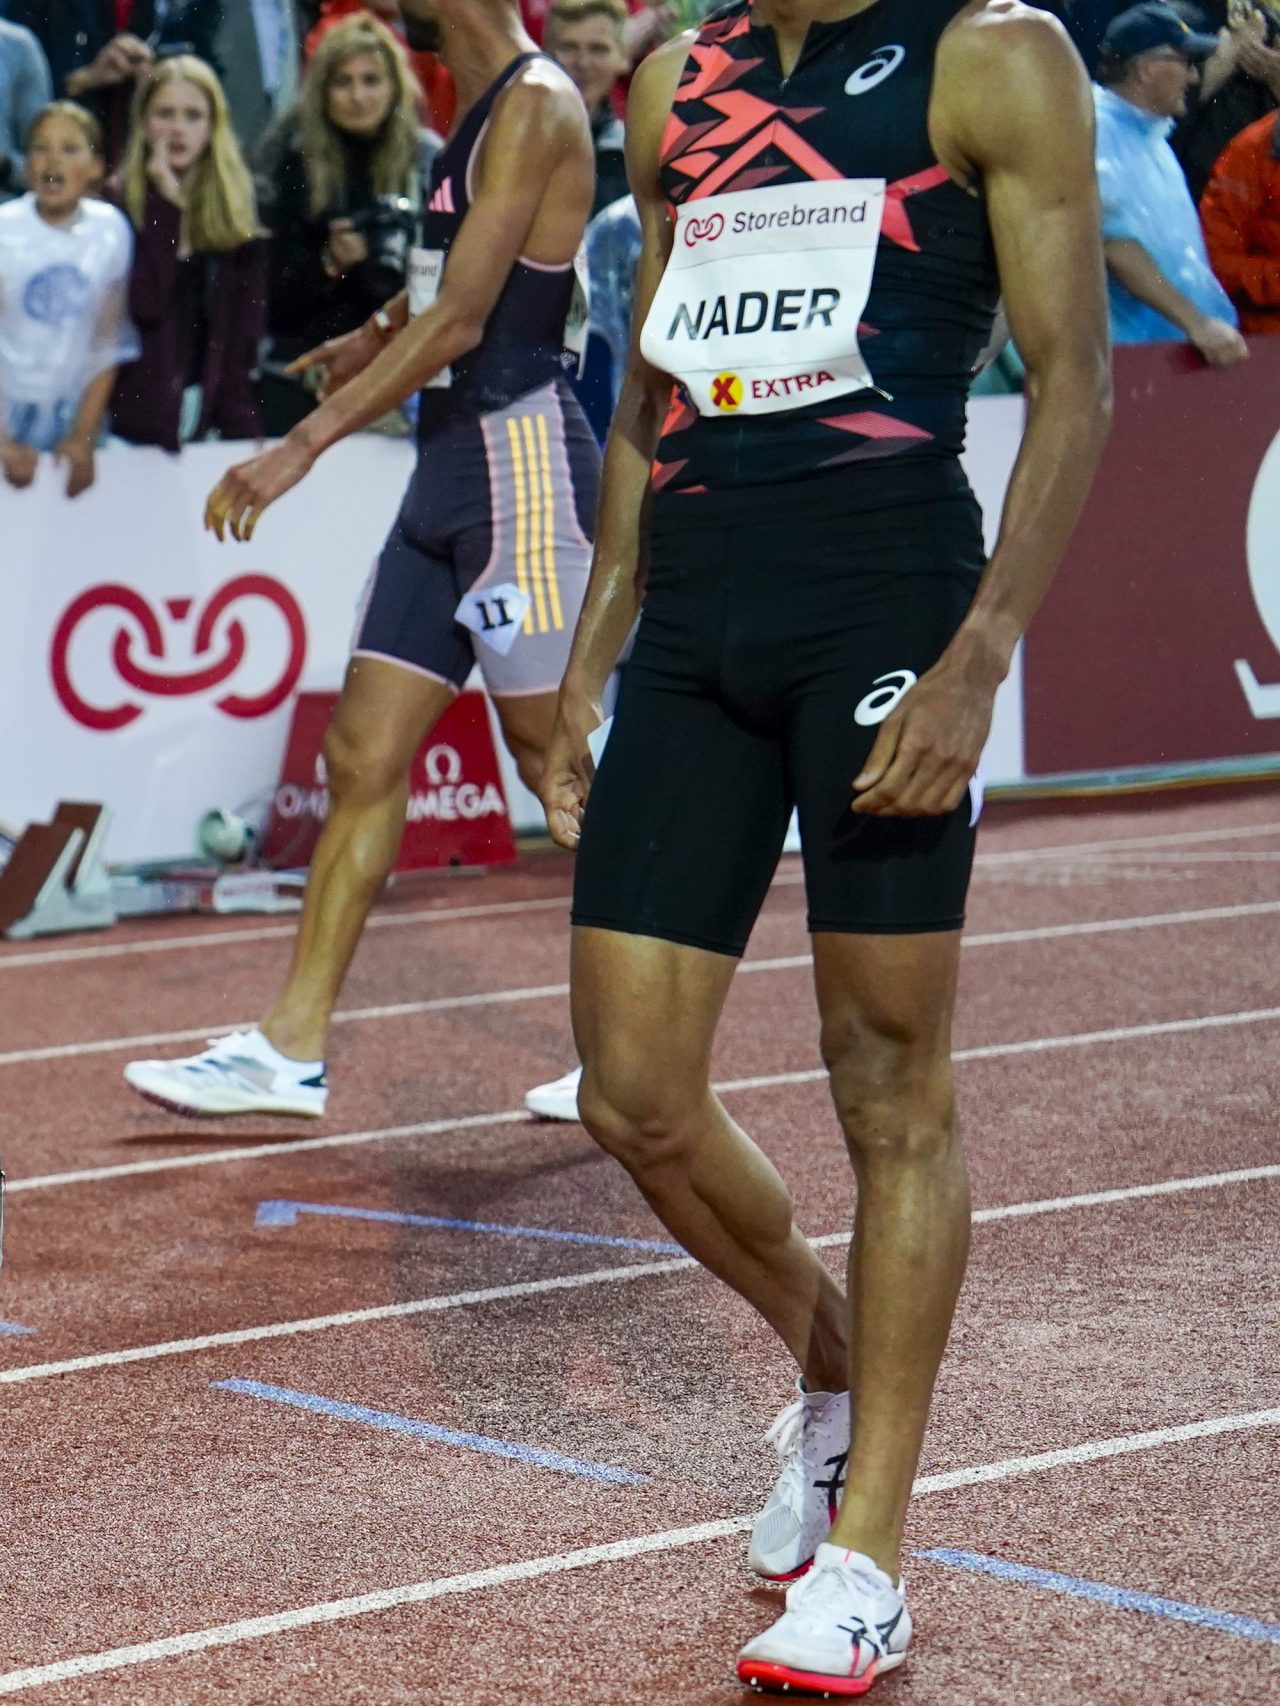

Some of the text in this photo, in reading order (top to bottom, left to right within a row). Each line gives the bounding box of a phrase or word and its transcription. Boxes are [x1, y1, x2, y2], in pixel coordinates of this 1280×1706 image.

[732, 200, 868, 234] Storebrand
[665, 287, 841, 341] NADER
[750, 370, 836, 399] EXTRA
[475, 597, 515, 632] 11
[406, 782, 507, 822] MEGA
